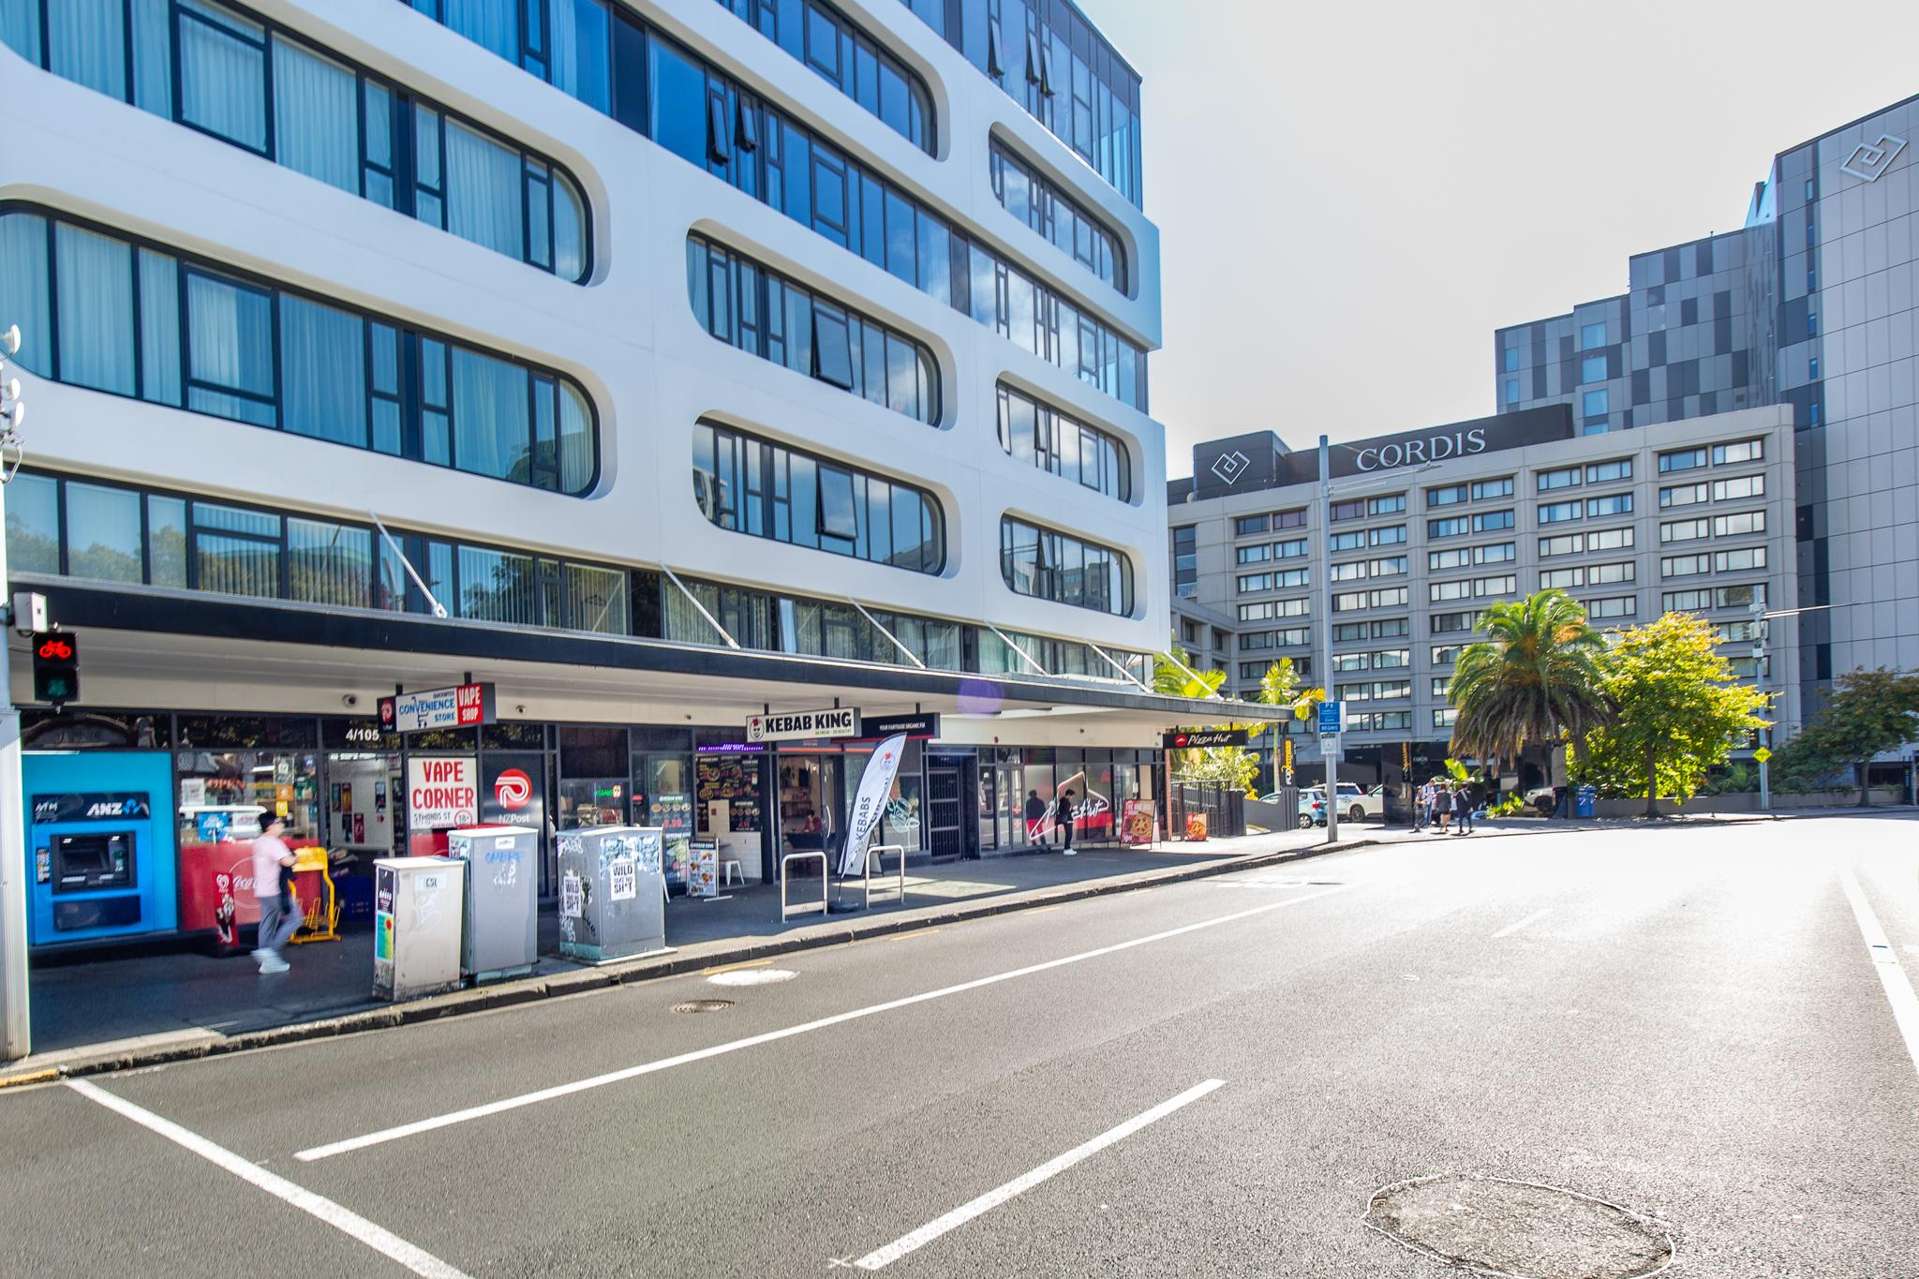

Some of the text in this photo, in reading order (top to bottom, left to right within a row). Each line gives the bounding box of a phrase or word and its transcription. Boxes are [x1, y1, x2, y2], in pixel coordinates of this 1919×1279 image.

[1355, 428, 1487, 471] CORDIS
[458, 686, 481, 707] VAPE
[398, 697, 456, 714] CONVENIENCE
[434, 712, 456, 722] STORE
[462, 707, 479, 722] SHOP
[765, 711, 852, 733] KEBAB KING
[345, 728, 380, 742] 4/105
[1187, 733, 1233, 746] Pizza Hut
[423, 761, 464, 783] VAPE
[412, 787, 474, 809] CORNER
[86, 802, 123, 817] ANZ
[855, 796, 871, 841] KEBABS
[613, 865, 633, 876] WILD
